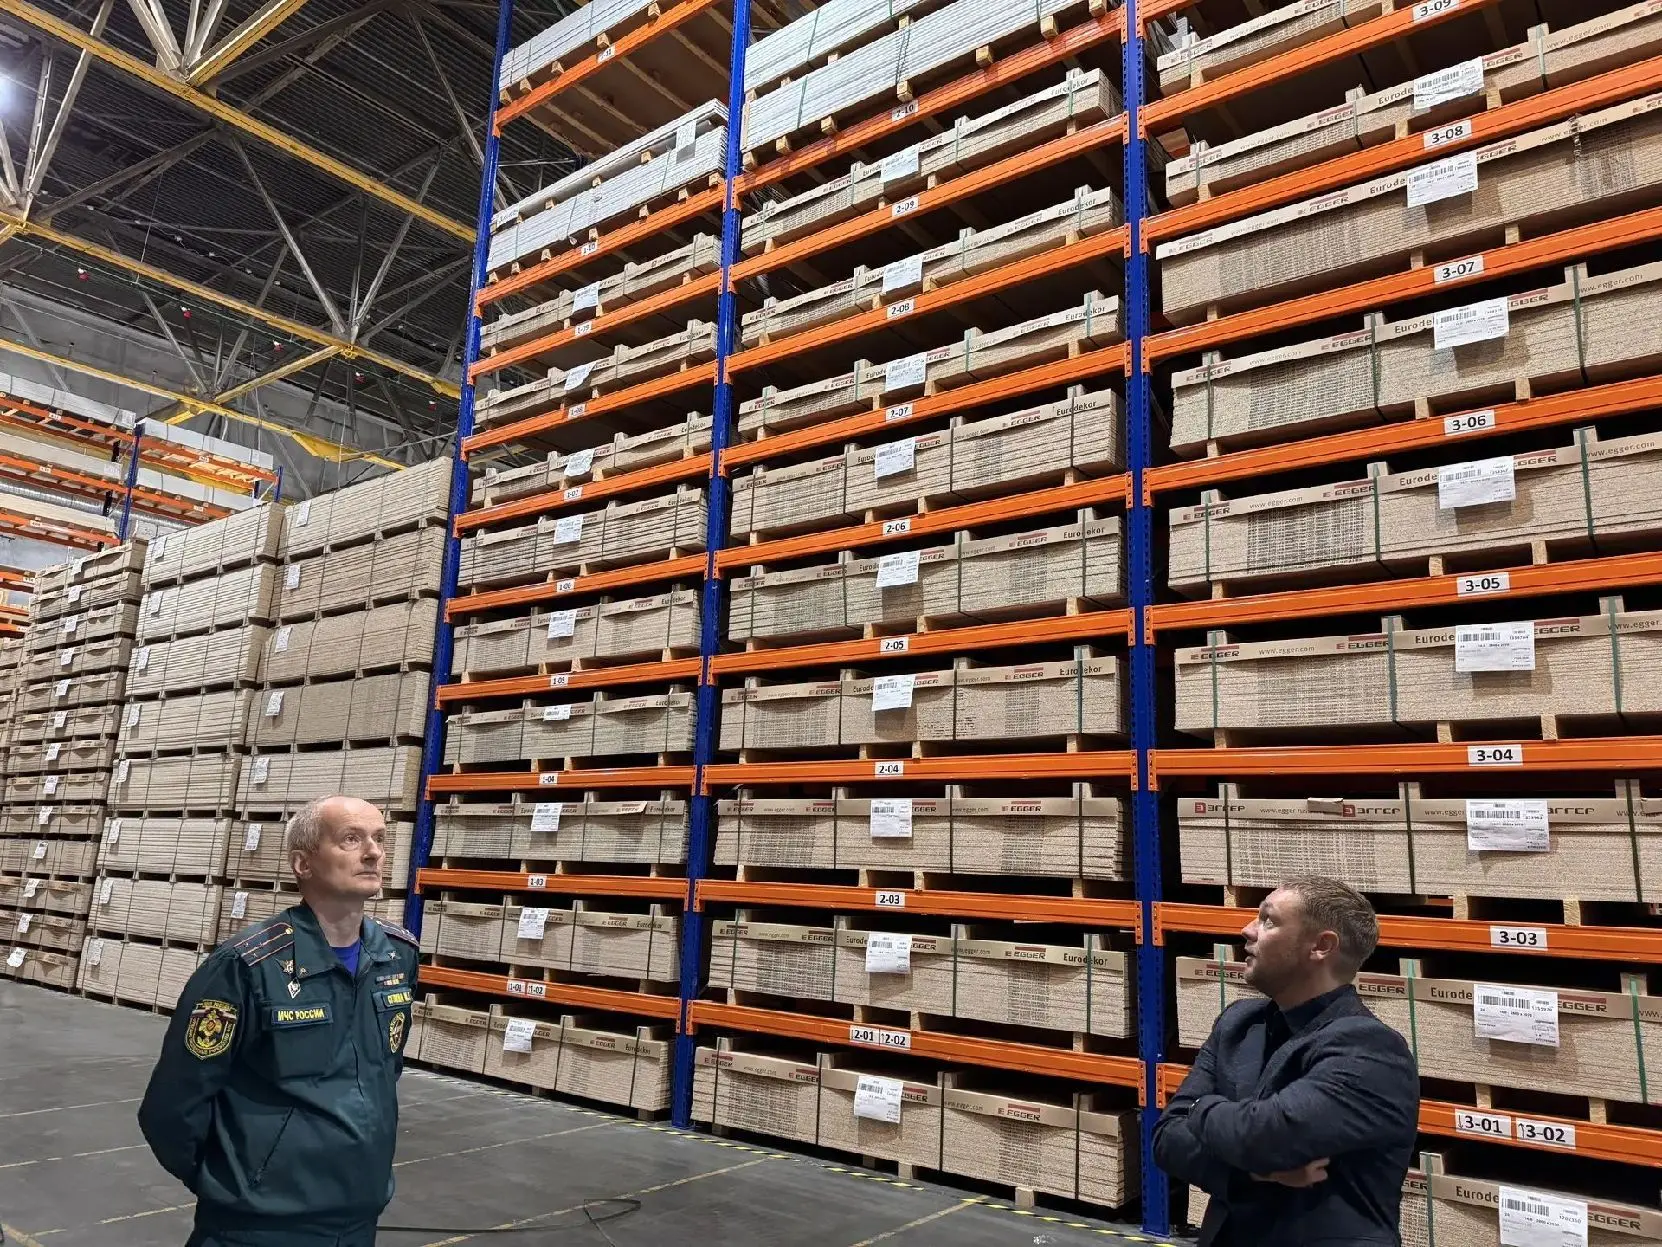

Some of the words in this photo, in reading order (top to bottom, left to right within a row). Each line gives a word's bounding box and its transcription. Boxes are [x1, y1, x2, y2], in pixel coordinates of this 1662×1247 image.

[1420, 0, 1450, 17] 3-09
[1379, 84, 1414, 105] Eurode
[1431, 125, 1463, 144] 3-08
[1370, 178, 1406, 195] Eurode
[896, 200, 915, 214] 2-09
[1442, 261, 1475, 279] 3-07
[891, 303, 910, 315] 2-08
[1394, 319, 1432, 334] Eurode
[866, 368, 886, 379] Eurode
[891, 406, 908, 417] 2-07
[1452, 416, 1486, 431] 3-06
[1399, 472, 1437, 486] Eurode
[886, 524, 906, 533] 2-06
[1063, 526, 1106, 539] Euroekor
[859, 563, 880, 572] Eurode
[1465, 577, 1500, 592] 3-05
[1607, 620, 1662, 631] www.egger.
[885, 640, 904, 650] 2-05
[1347, 640, 1390, 650] EGGER
[1415, 633, 1454, 644] Eurode
[1059, 666, 1102, 676] Euroekor
[853, 685, 874, 693] Eurode
[1477, 749, 1514, 761] 3-04
[878, 764, 899, 773] 2-04
[879, 894, 900, 904] 2-03
[846, 936, 868, 945] Eurode
[1499, 931, 1538, 946] 3-03
[1014, 951, 1046, 960] EGGER
[1358, 983, 1405, 995] EGGER
[1431, 986, 1473, 1000] Eurode
[278, 1011, 293, 1021] МЧС
[854, 1029, 874, 1041] 2-01
[885, 1034, 906, 1046] 2-02
[1007, 1110, 1041, 1121] EGGER
[1464, 1115, 1503, 1134] 3-01
[1526, 1124, 1566, 1143] 3-02
[1455, 1185, 1499, 1203] Eurode
